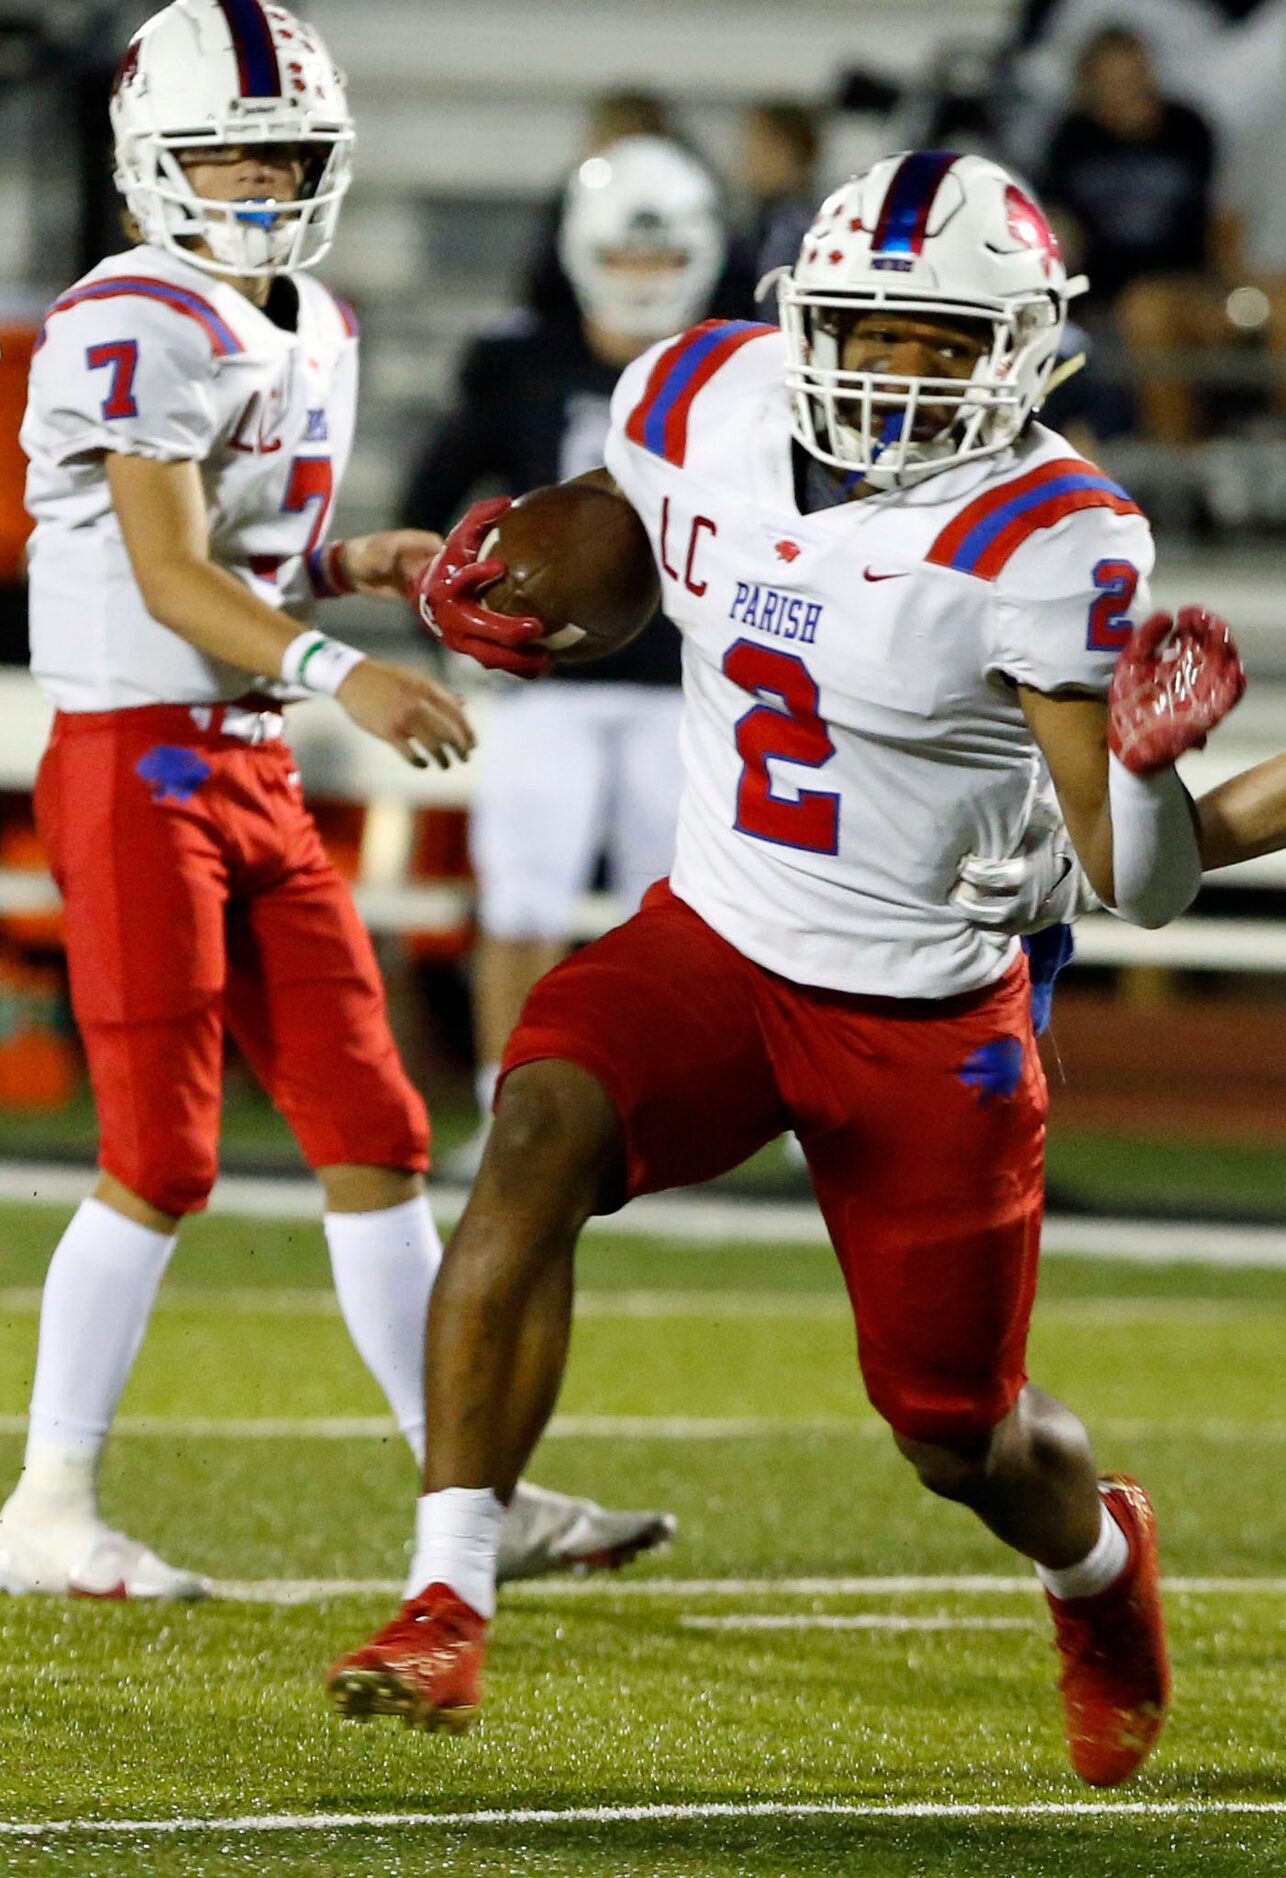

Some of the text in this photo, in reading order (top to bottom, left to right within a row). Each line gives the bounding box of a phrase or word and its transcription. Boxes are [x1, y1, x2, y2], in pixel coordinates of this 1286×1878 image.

[86, 338, 138, 420] 7
[661, 496, 717, 597] LC
[729, 580, 823, 644] PARISH
[1086, 558, 1139, 651] 2
[721, 636, 841, 857] 2
